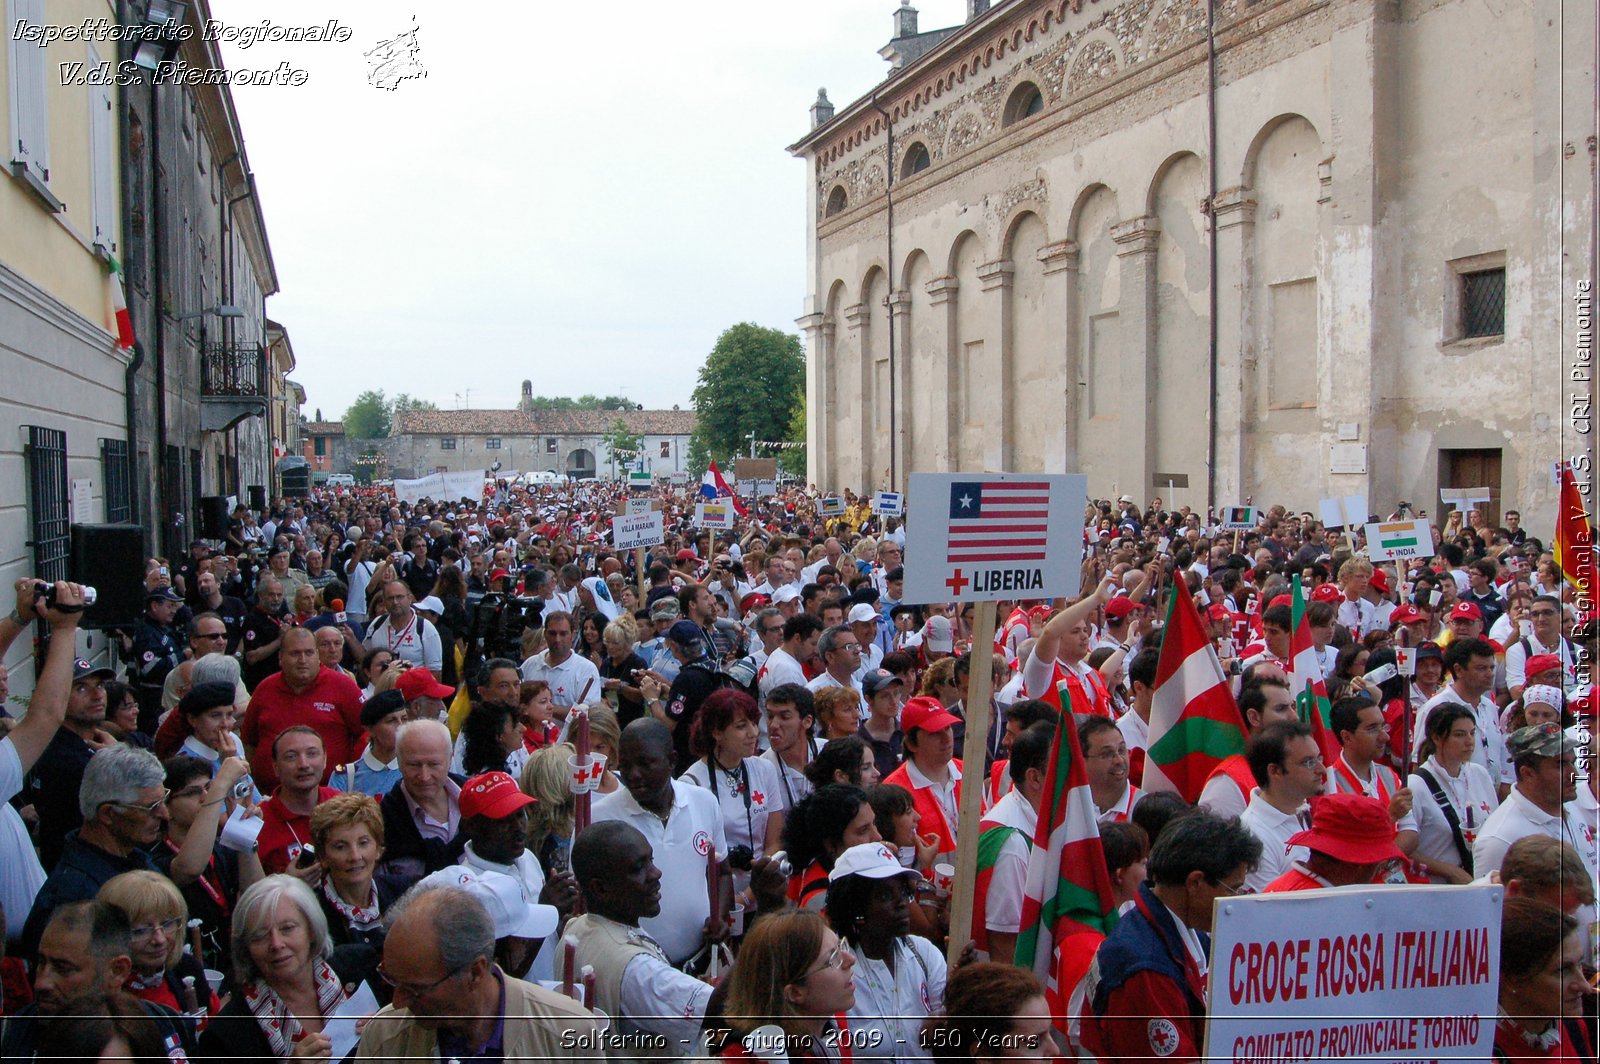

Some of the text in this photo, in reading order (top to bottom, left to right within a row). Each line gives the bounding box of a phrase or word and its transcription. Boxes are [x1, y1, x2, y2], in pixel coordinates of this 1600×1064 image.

[621, 524, 635, 533] VILLA
[619, 536, 660, 549] ROME CONSENSUS
[1395, 548, 1416, 557] INDIA
[973, 568, 1044, 592] LIBERIA
[1229, 927, 1489, 1006] CROCE ROSSA ITALIANA
[1232, 1013, 1480, 1064] COMITATO PROVINCIALE TORINO
